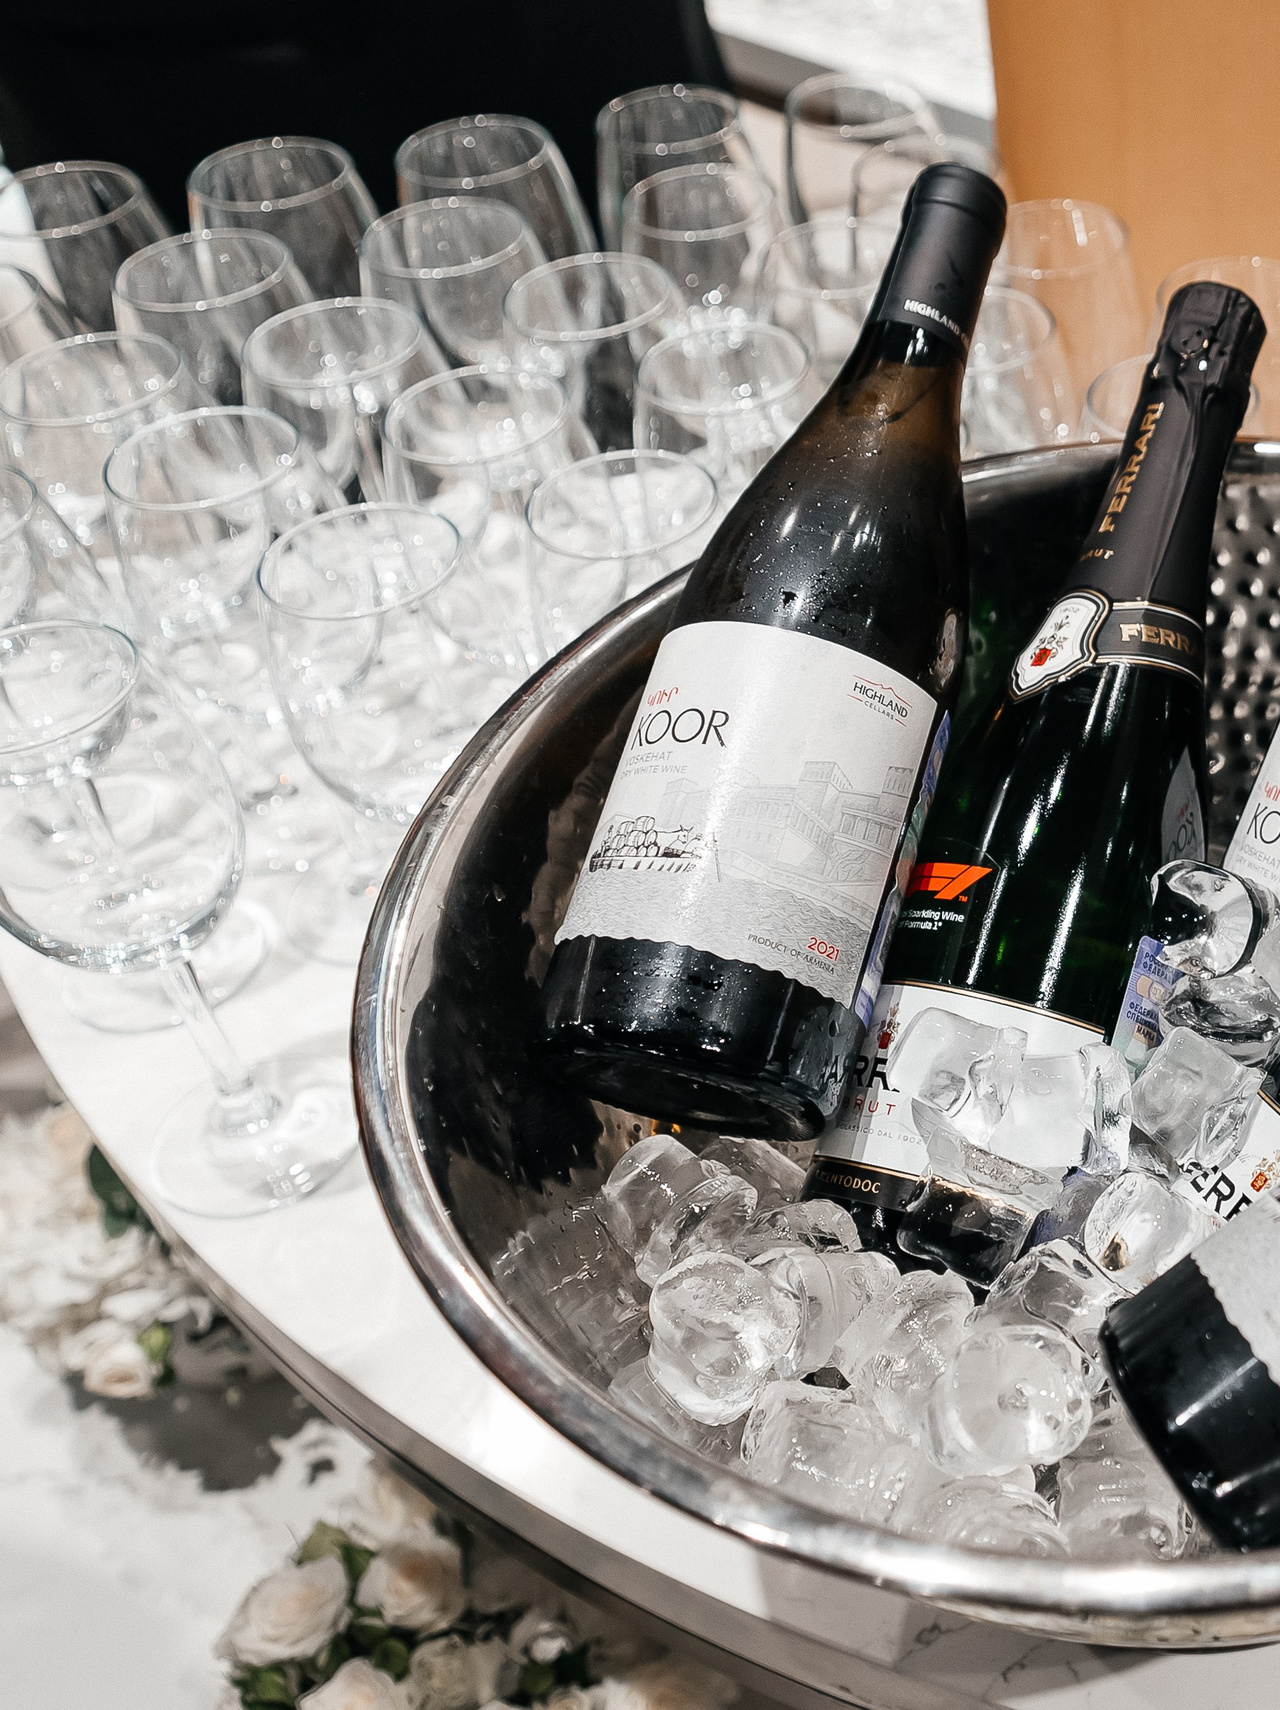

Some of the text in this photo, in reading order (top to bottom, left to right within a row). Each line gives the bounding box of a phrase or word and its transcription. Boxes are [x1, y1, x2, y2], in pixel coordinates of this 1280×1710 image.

[904, 299, 961, 336] HIGHLAND
[1098, 401, 1165, 533] FERRARI
[853, 681, 909, 719] HIGHLAND
[864, 700, 895, 721] CELLARS
[630, 707, 729, 751] KOOR
[634, 764, 660, 776] WHITE
[661, 764, 688, 775] WINE
[941, 910, 965, 923] Wine
[747, 933, 835, 975] PRODUCT OF ARMENIA
[807, 936, 841, 962] 2021
[876, 1129, 893, 1140] DAL
[897, 1134, 923, 1146] 1902
